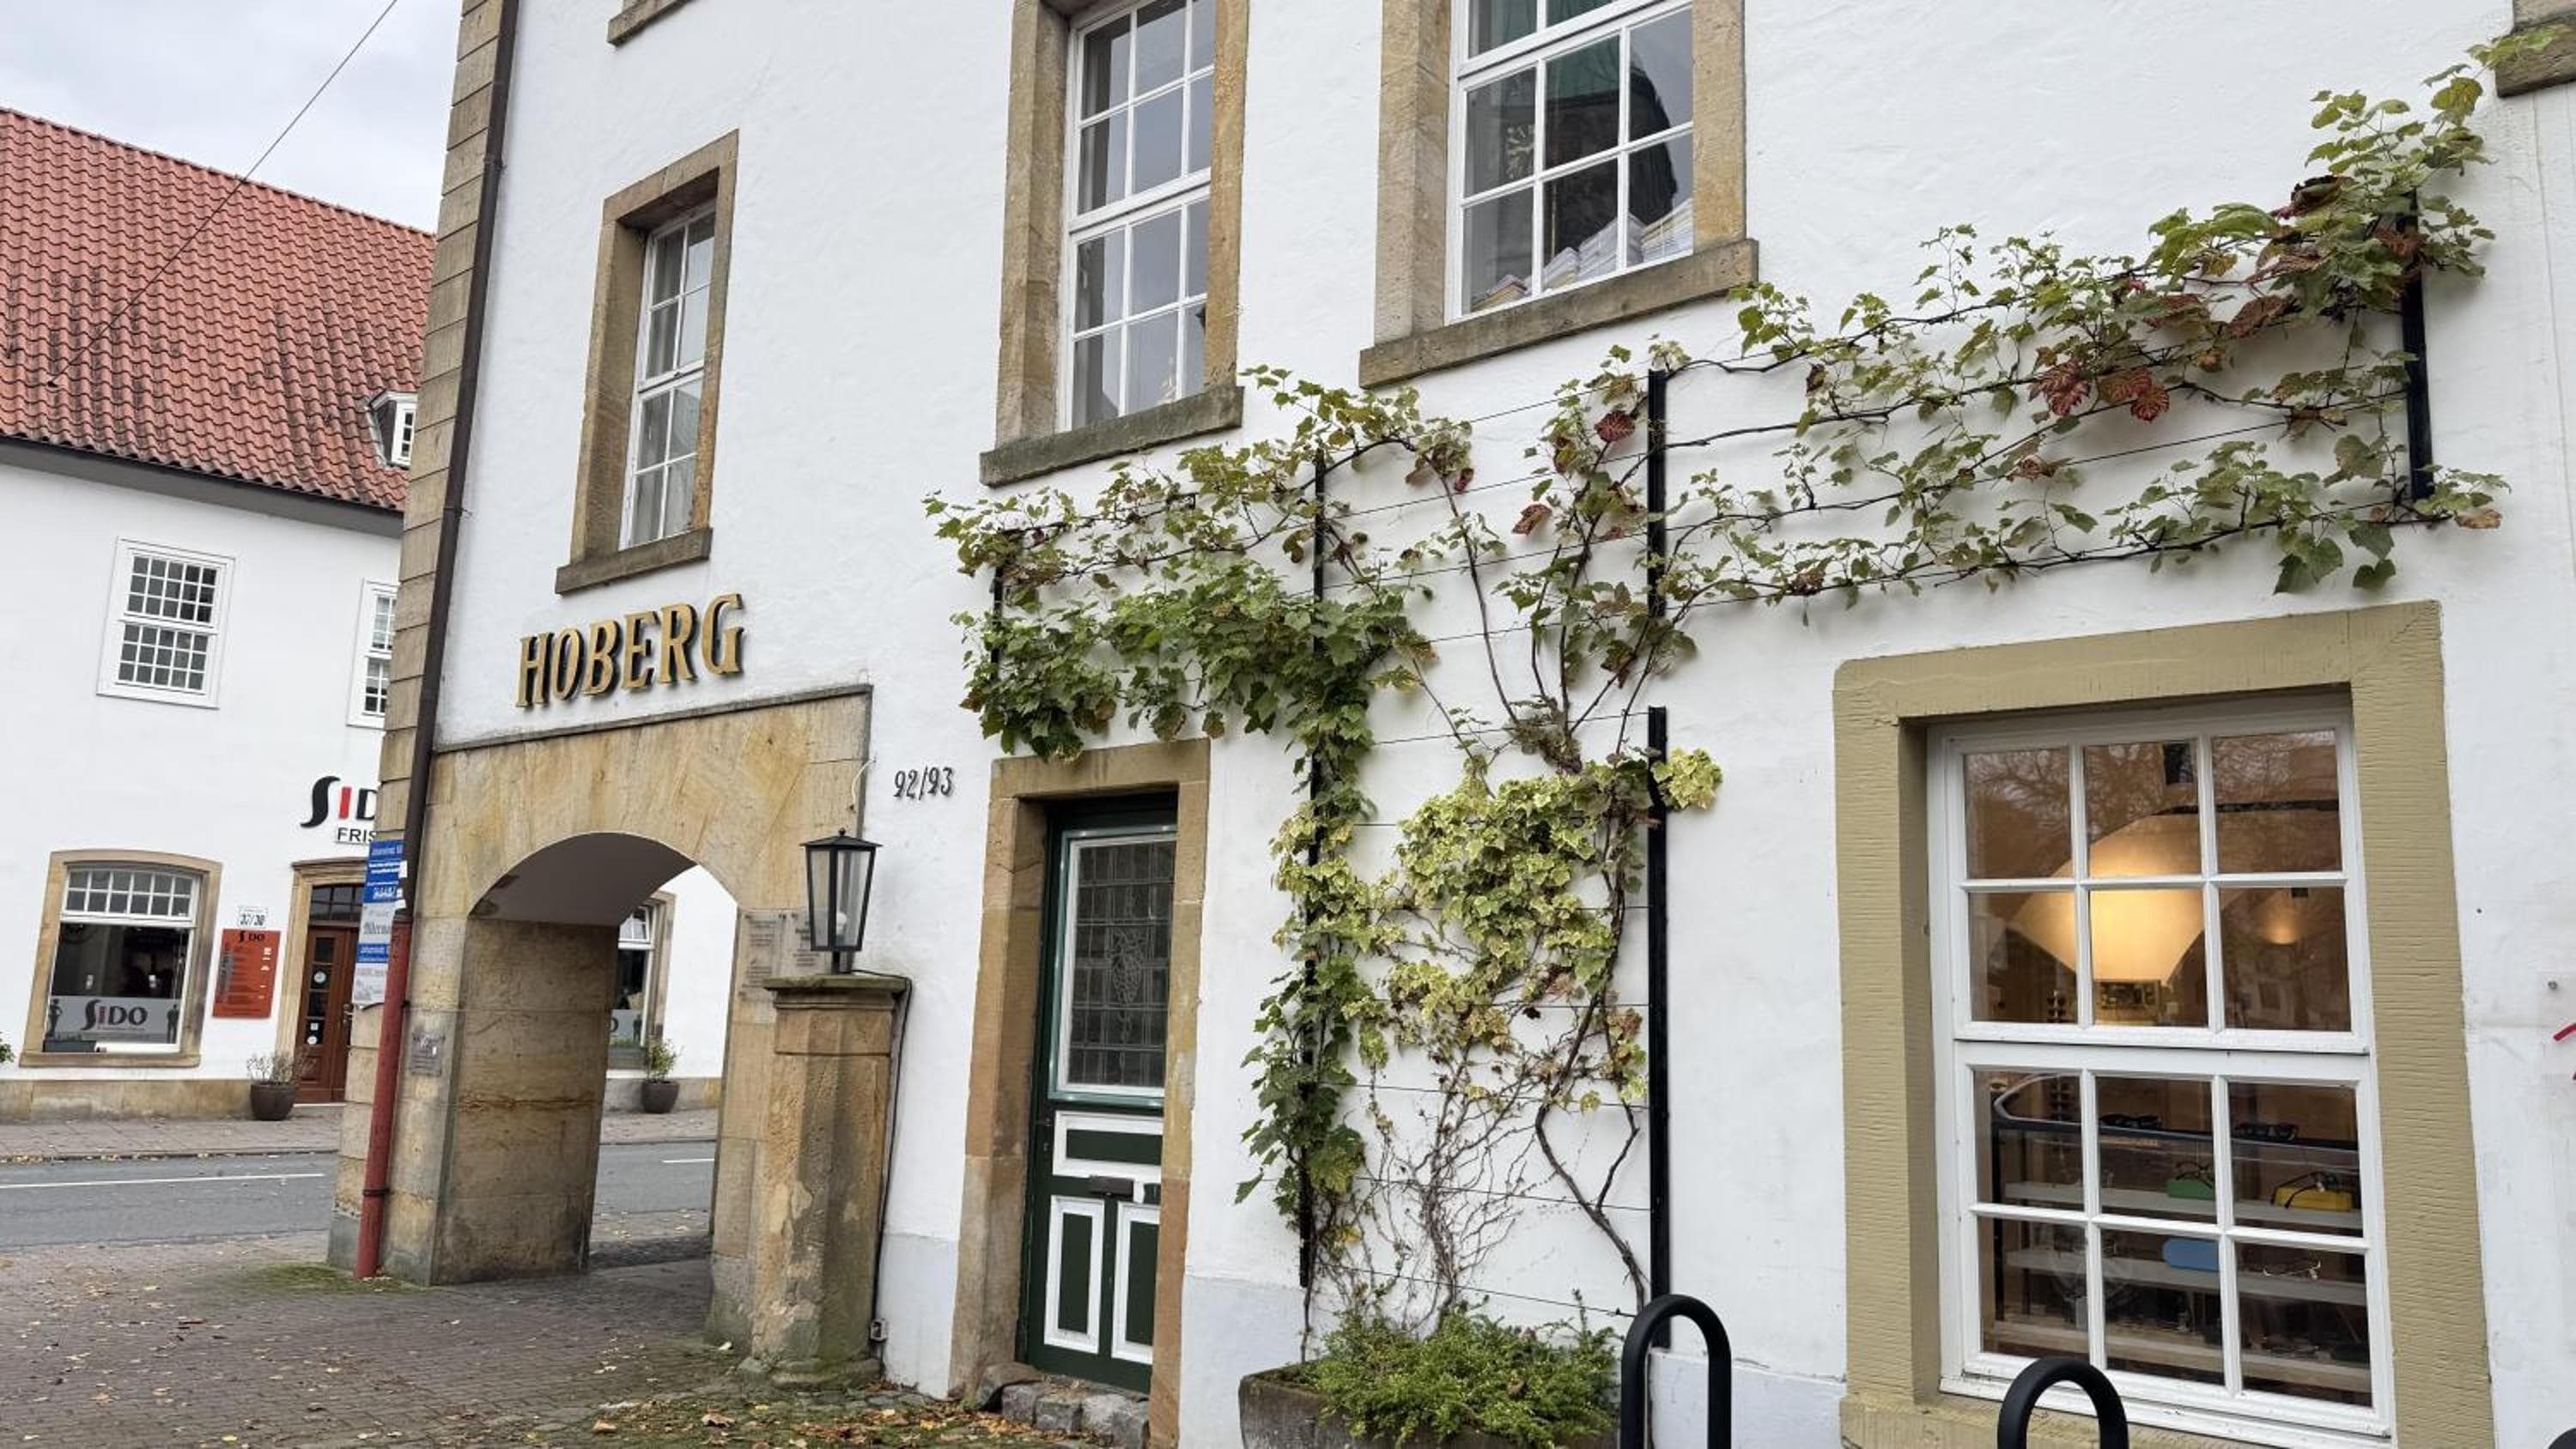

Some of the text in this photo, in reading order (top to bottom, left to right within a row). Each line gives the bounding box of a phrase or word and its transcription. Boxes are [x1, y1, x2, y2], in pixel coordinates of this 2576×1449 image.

[515, 592, 744, 707] HOBERG
[893, 766, 953, 801] 92/93
[81, 999, 149, 1031] SIDO
